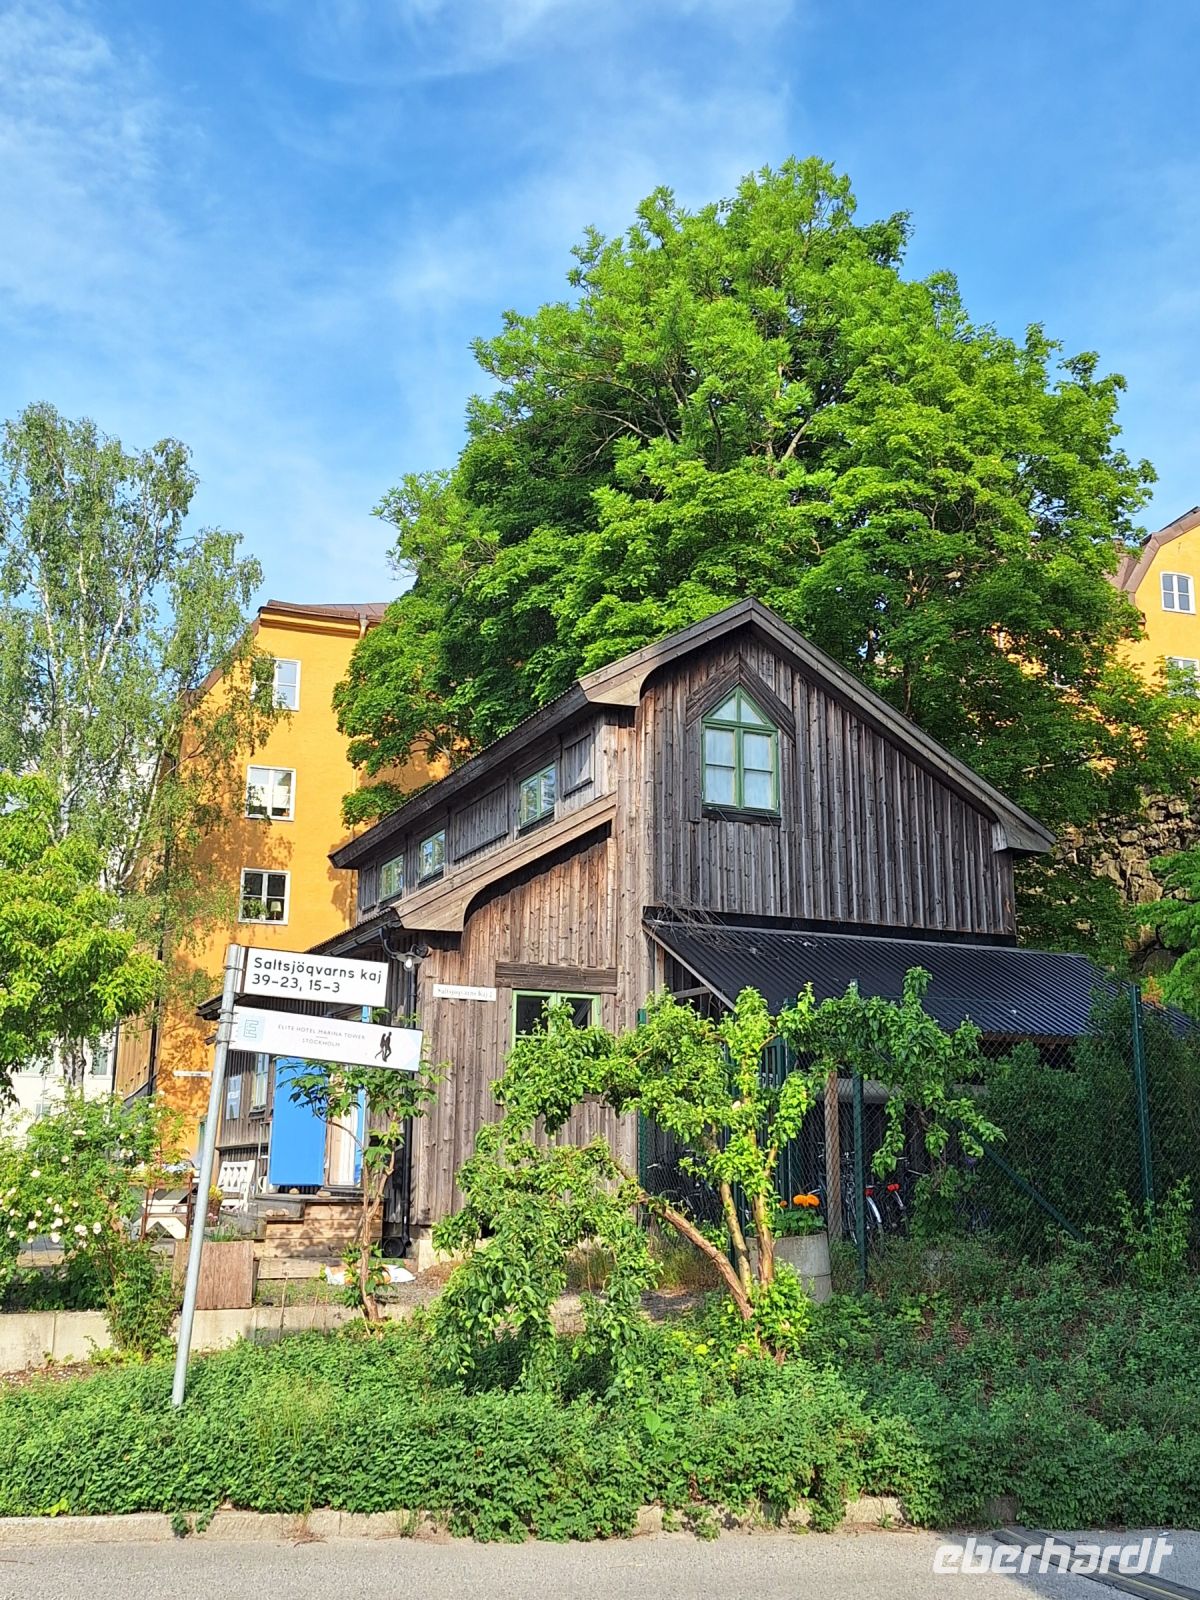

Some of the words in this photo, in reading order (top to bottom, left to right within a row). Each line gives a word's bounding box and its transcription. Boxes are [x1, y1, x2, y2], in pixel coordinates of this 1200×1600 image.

[253, 957, 355, 979] Saltsjöqvarns
[360, 968, 382, 984] kaj
[252, 974, 302, 992] 39-23,
[309, 979, 341, 993] 15-3
[278, 1024, 295, 1032] ELITE
[296, 1026, 316, 1034] HOTEL
[317, 1028, 342, 1037] MARINA
[344, 1032, 366, 1040] TOWER
[301, 1038, 341, 1047] STOCKHOLM
